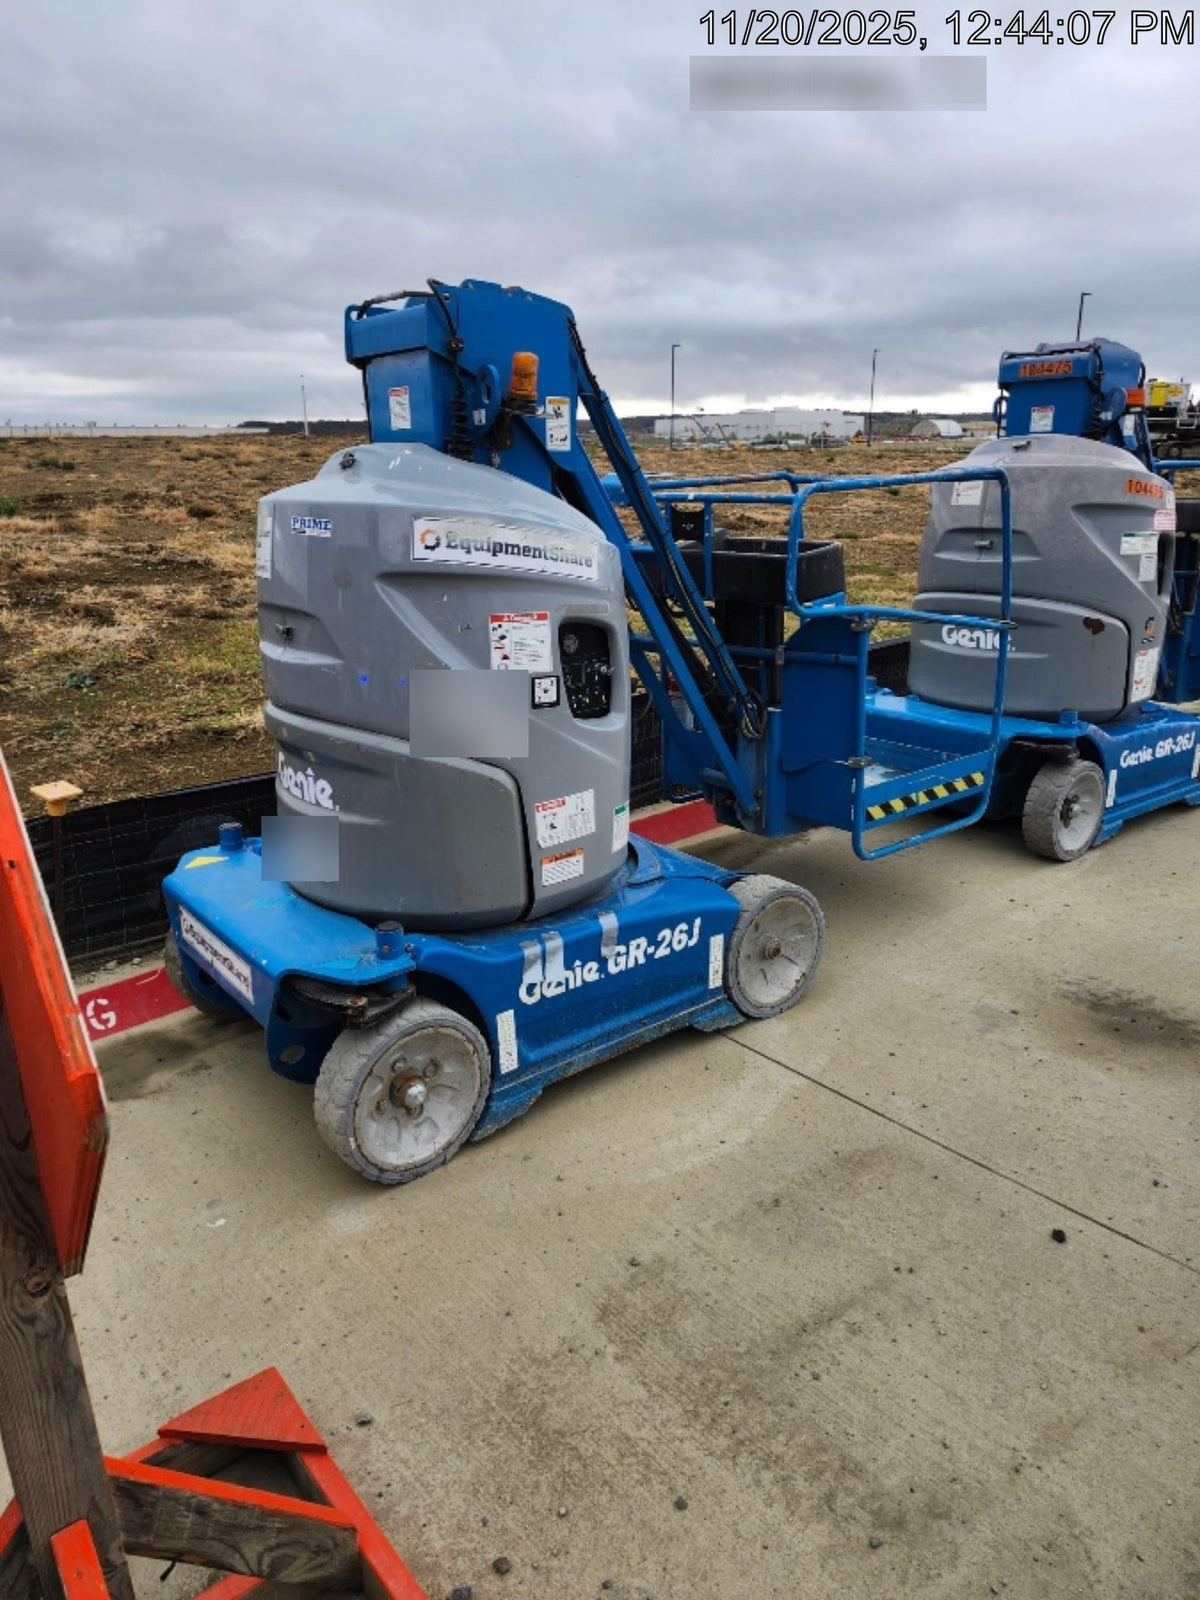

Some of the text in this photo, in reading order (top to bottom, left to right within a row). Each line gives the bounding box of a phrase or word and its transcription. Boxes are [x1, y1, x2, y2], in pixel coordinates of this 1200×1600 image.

[291, 515, 332, 530] PRIME
[444, 530, 593, 569] EquipmentShare
[1155, 731, 1196, 758] GR-26J
[606, 917, 702, 975] GR-26J
